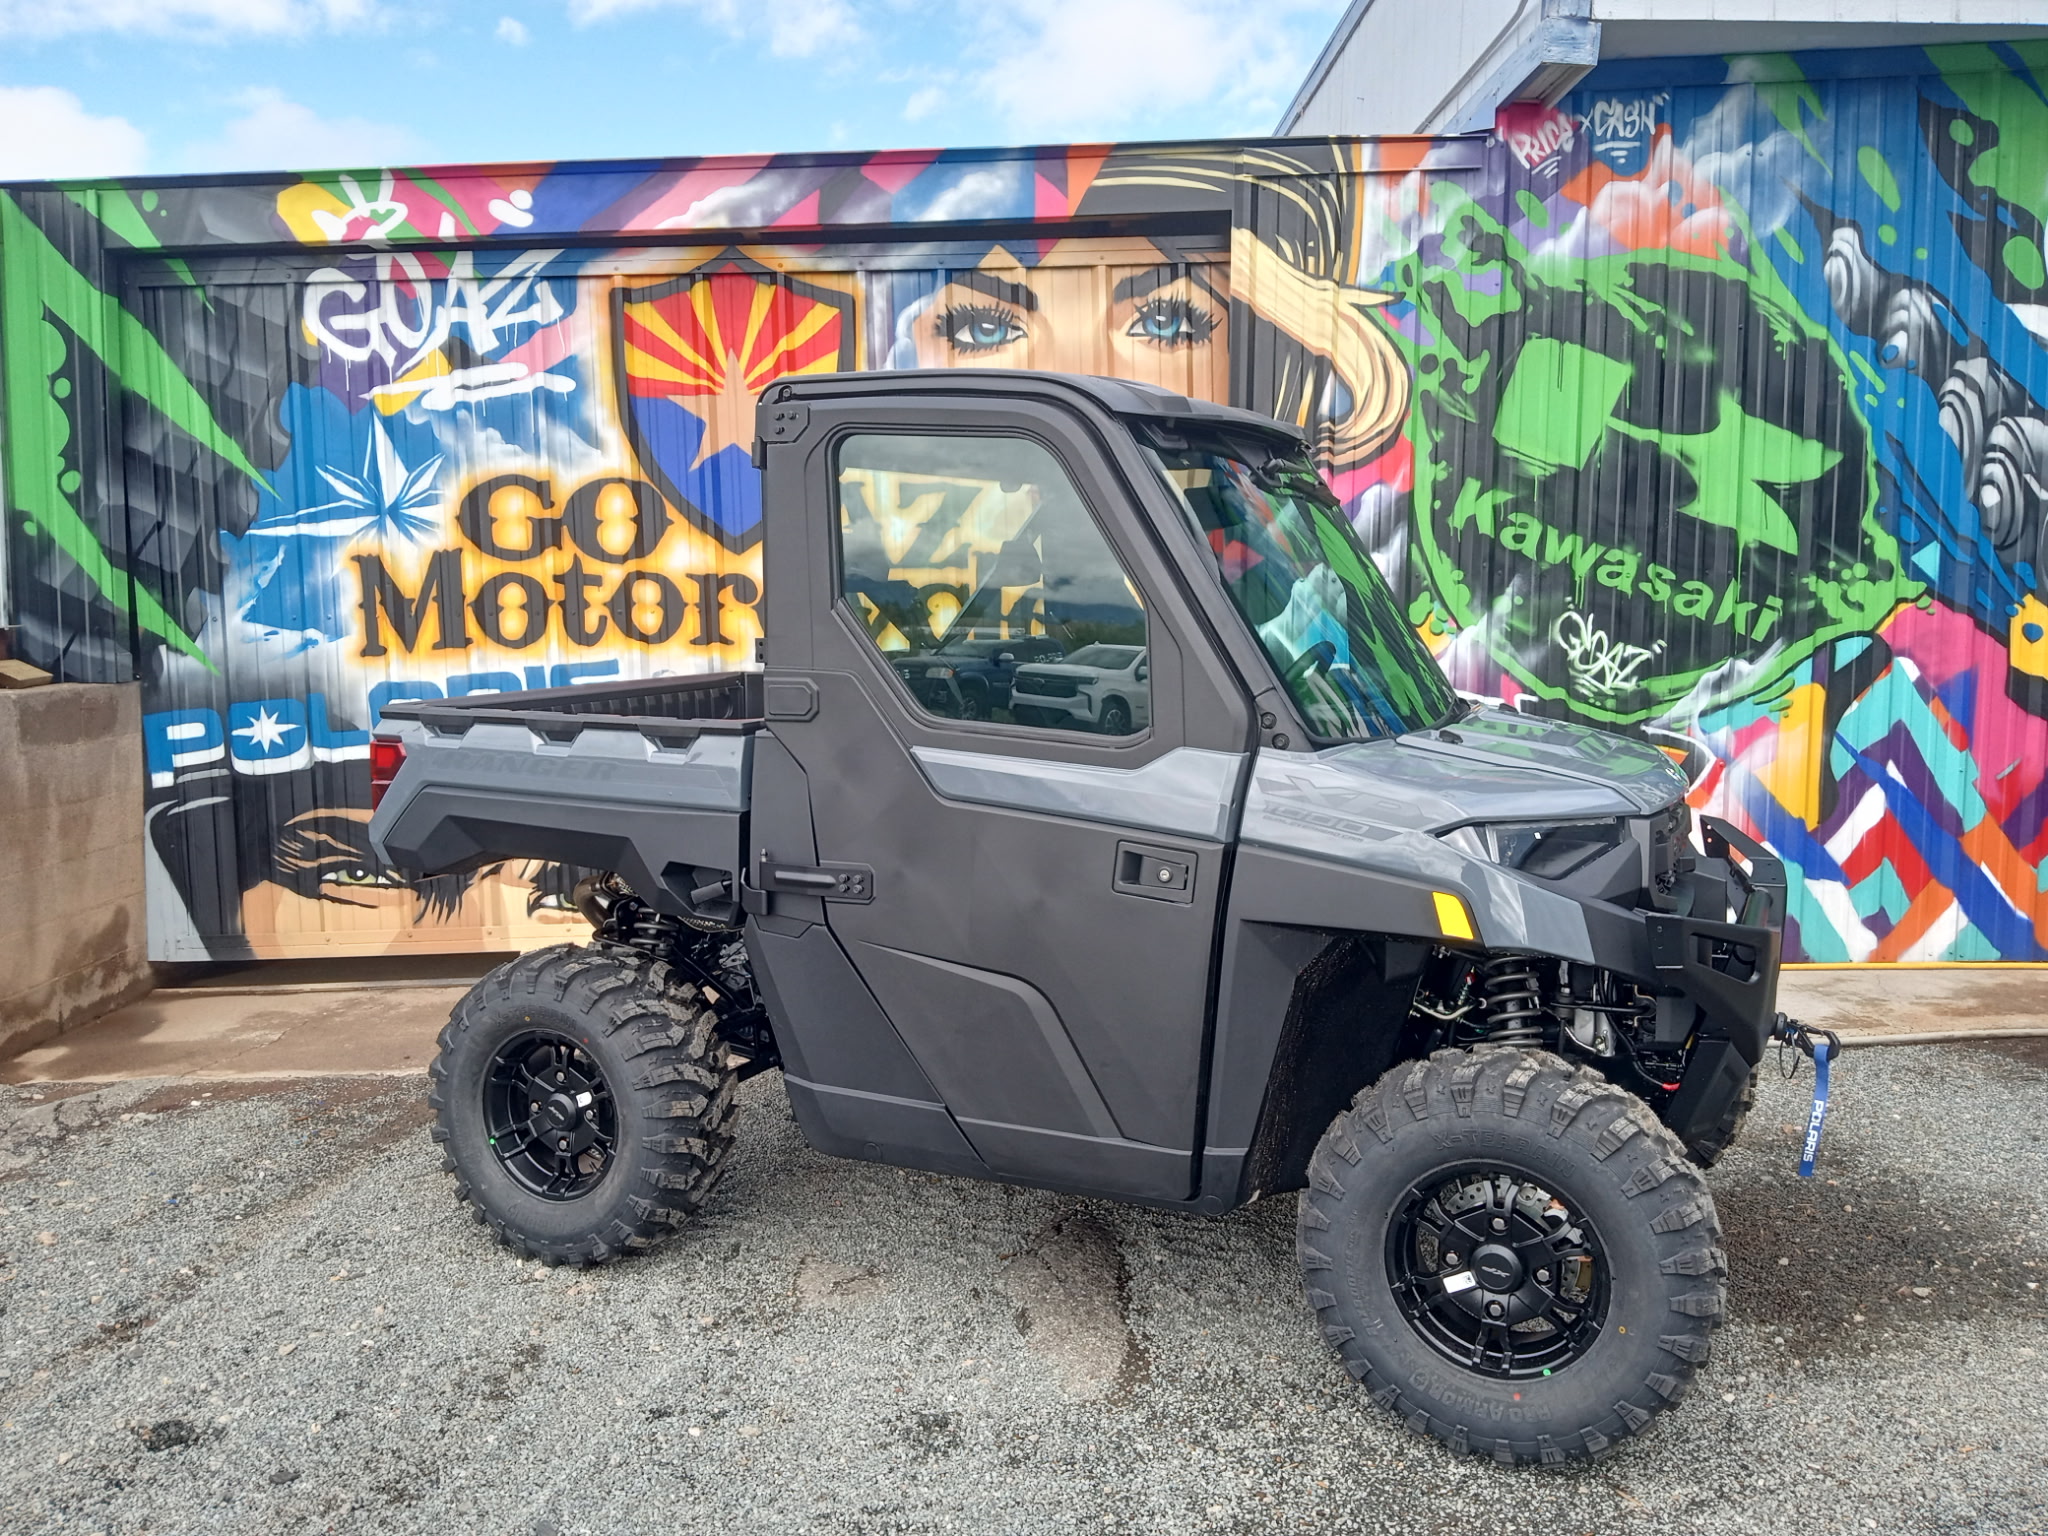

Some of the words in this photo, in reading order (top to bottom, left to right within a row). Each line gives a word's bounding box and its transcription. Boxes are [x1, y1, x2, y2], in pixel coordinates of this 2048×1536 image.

[456, 474, 675, 564] GO
[1447, 476, 1784, 643] Kawasaki
[351, 547, 765, 657] Motor
[431, 749, 620, 781] RANGER
[1802, 1099, 1825, 1163] POLARIS
